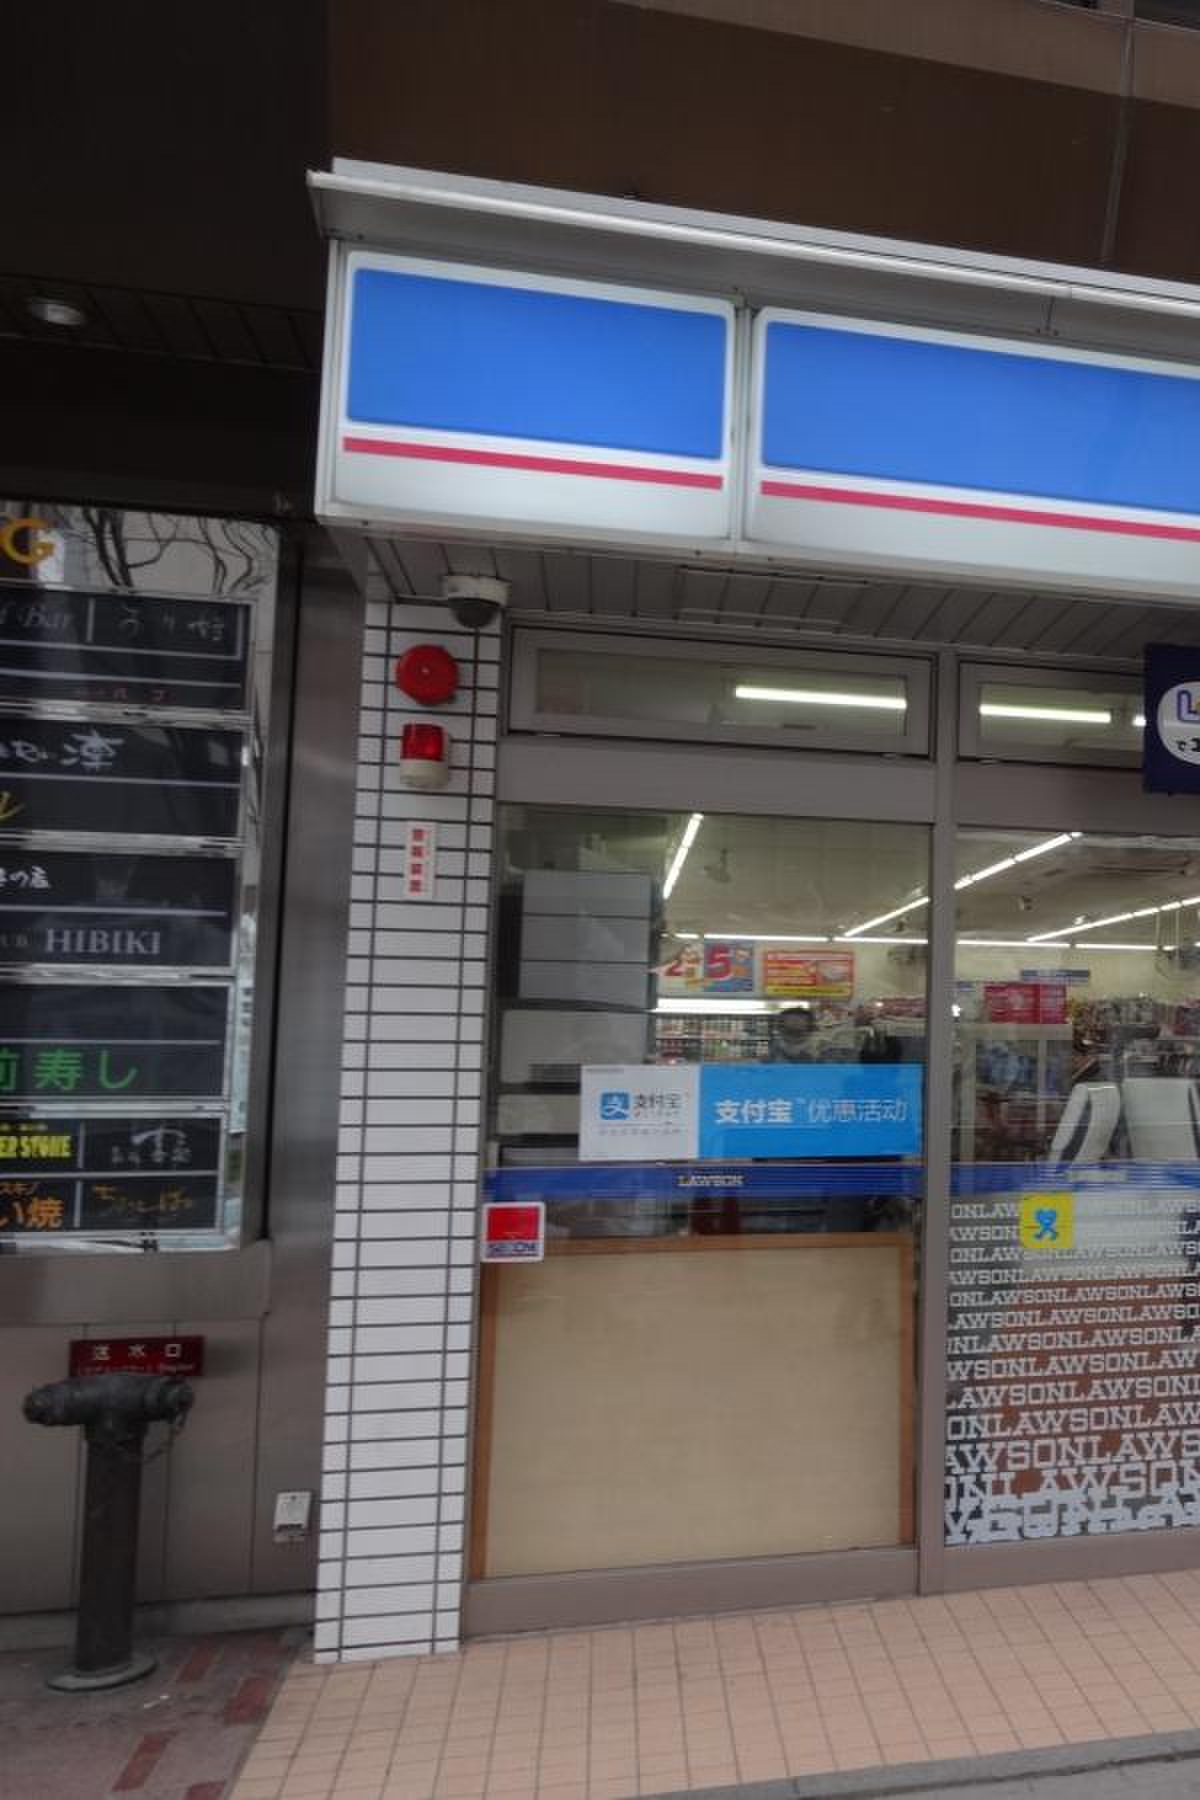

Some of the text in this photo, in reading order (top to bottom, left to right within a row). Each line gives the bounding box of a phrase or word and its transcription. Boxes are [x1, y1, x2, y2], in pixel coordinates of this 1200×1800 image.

[46, 928, 161, 954] HIBIKI
[715, 1099, 793, 1125] 支付宝
